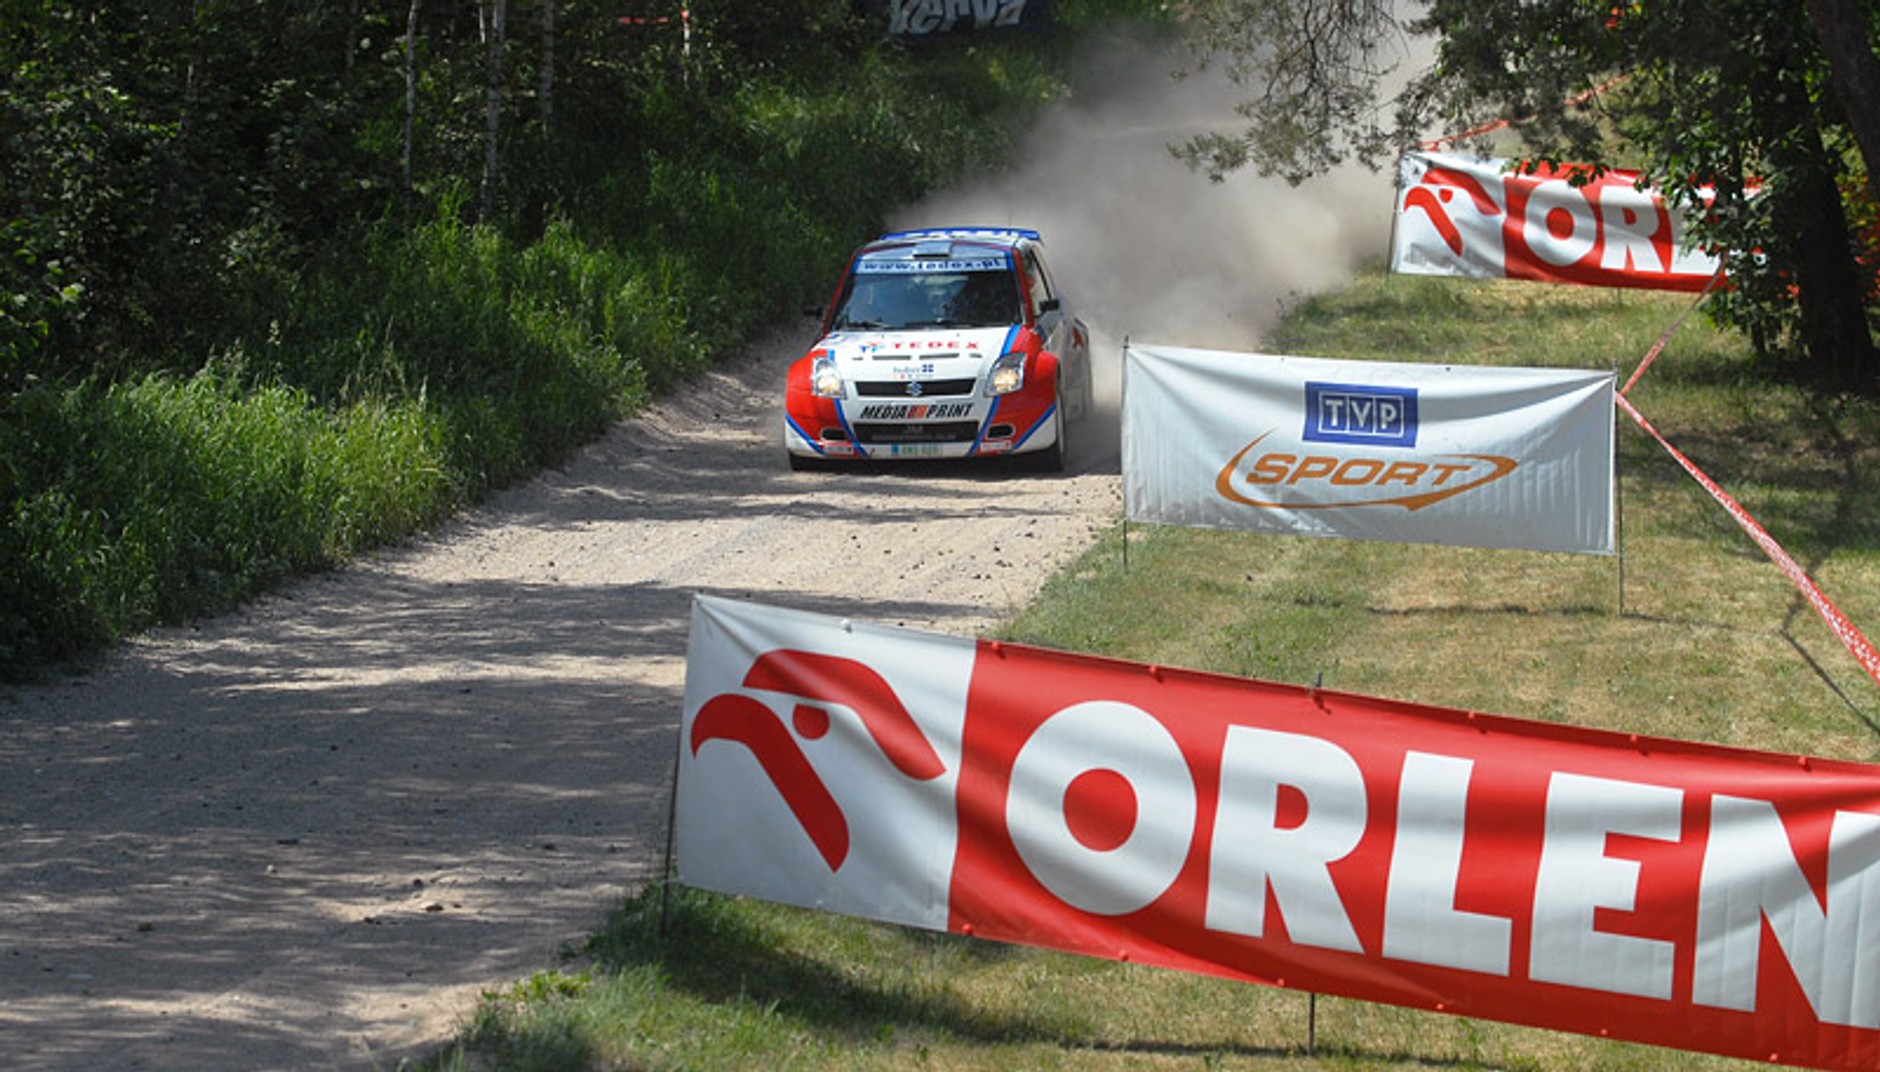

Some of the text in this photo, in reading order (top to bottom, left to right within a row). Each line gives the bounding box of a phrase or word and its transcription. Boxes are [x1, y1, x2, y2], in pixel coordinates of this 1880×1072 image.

[1522, 178, 1724, 276] ORL
[894, 341, 979, 350] TEDEX
[860, 402, 975, 419] MEDIA PRINT
[1324, 398, 1400, 434] TVP
[1245, 453, 1477, 486] SPORT
[1005, 700, 1880, 1028] ORLEN
